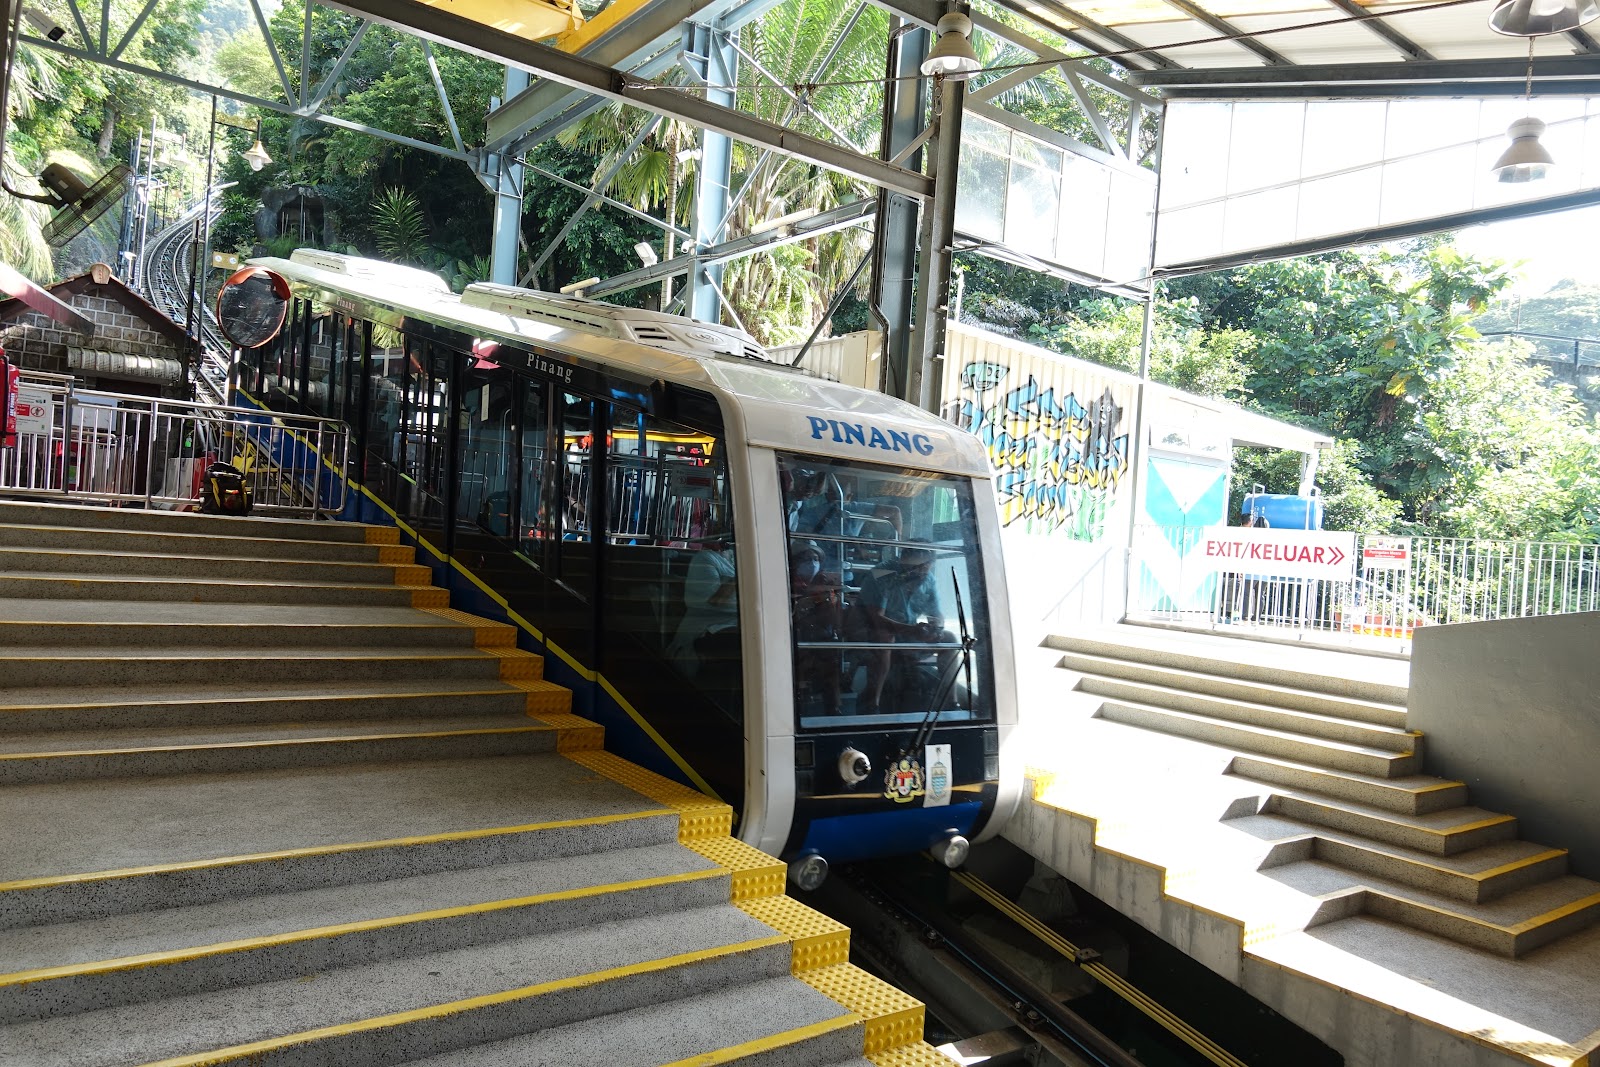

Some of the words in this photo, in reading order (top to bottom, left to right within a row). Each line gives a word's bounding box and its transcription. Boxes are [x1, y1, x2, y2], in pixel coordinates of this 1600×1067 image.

[526, 352, 573, 384] Pinang
[806, 415, 934, 456] PINANG
[1206, 540, 1325, 564] EXIT/KELUAR
